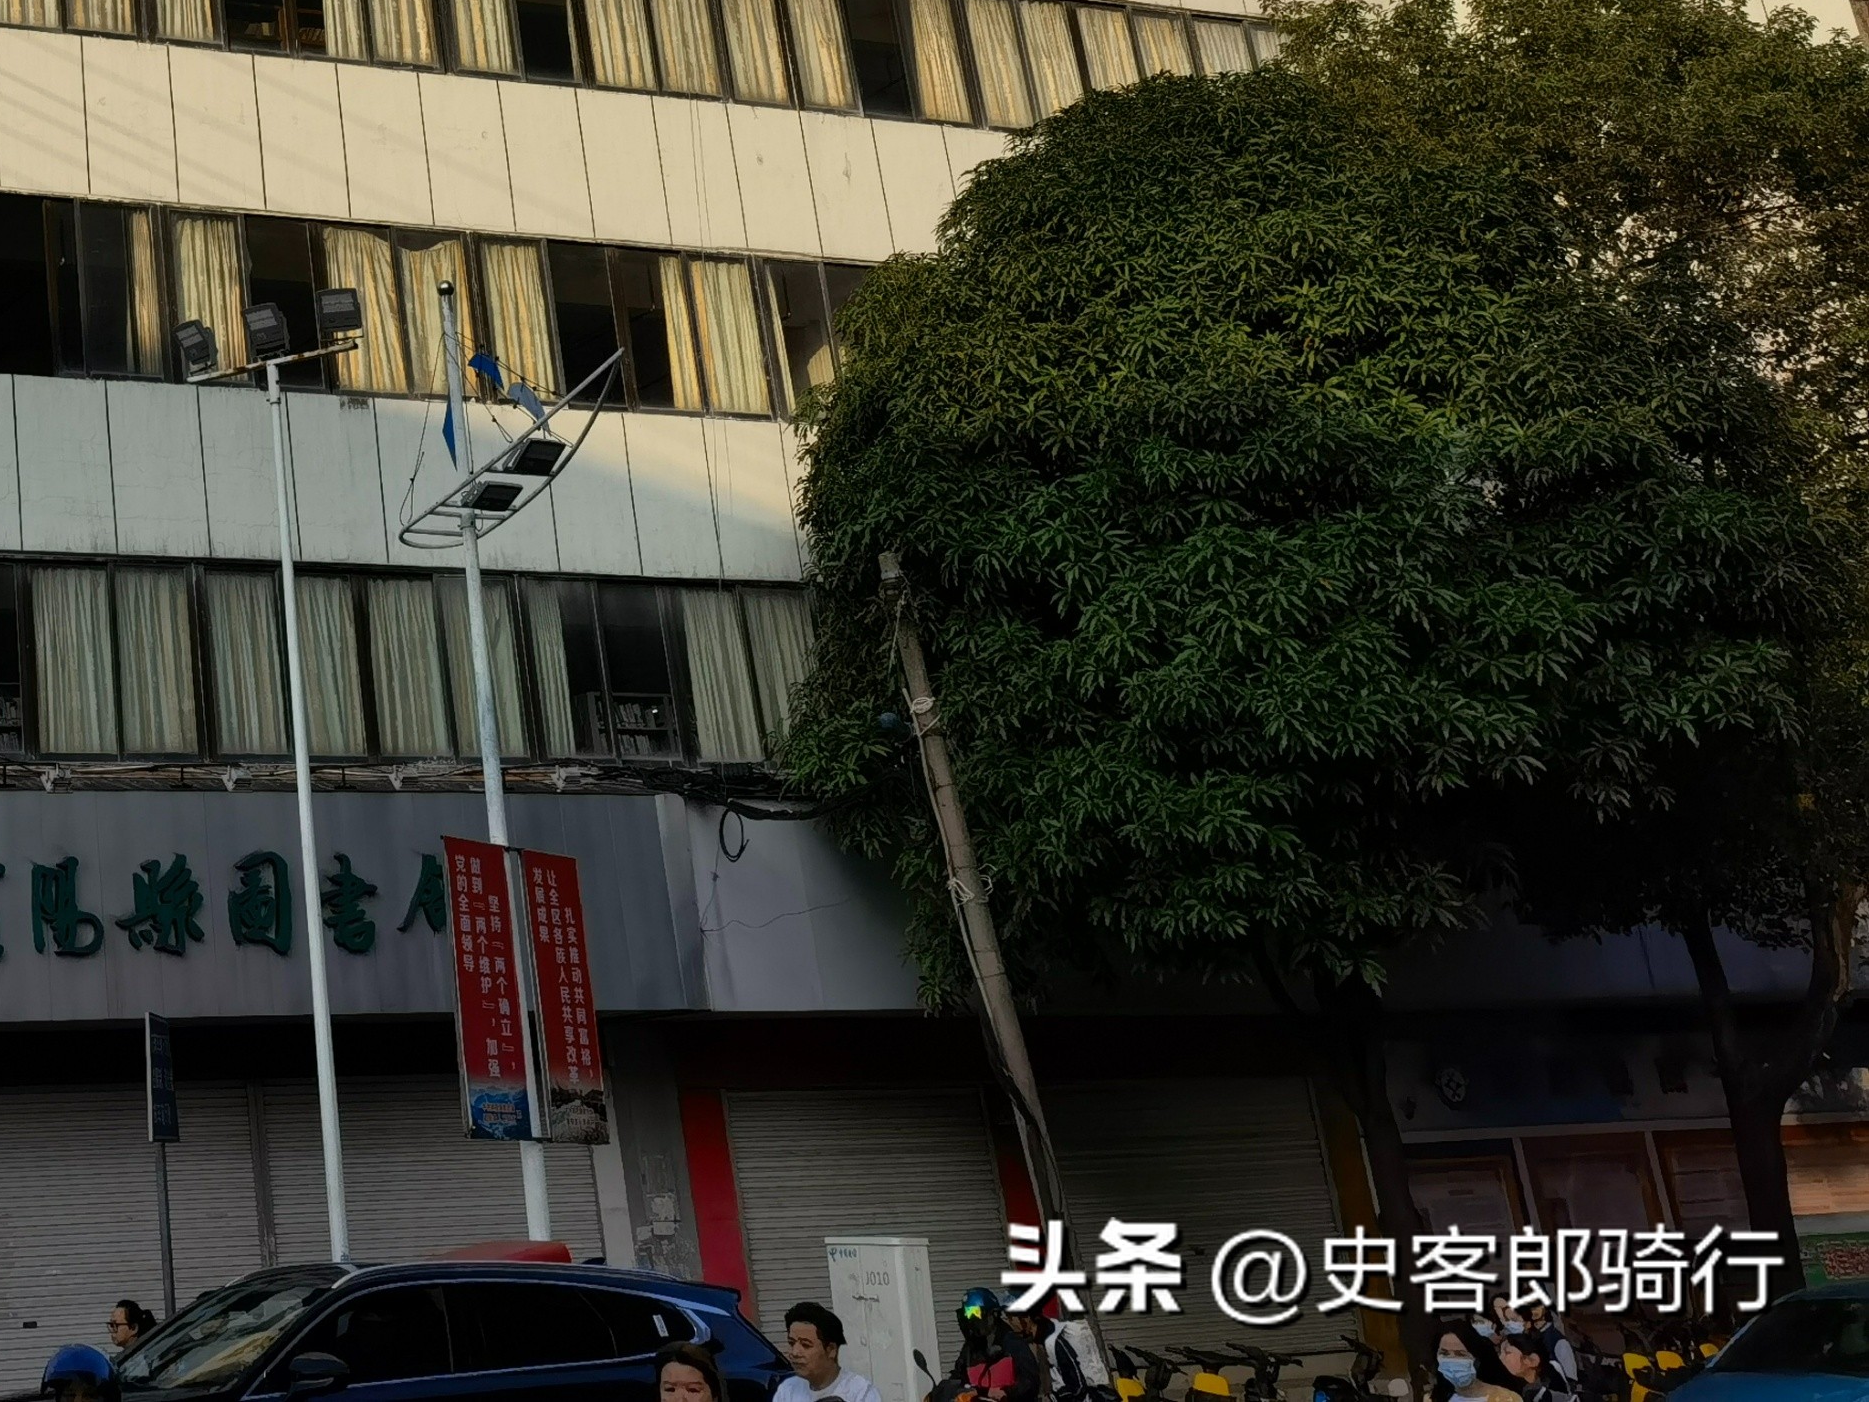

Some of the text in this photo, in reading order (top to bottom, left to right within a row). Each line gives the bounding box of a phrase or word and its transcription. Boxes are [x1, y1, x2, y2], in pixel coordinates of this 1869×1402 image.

[454, 855, 475, 973] 党的全面领导
[532, 867, 550, 943] 发展成果
[546, 869, 580, 1084] 让全区各族人民共享改革
